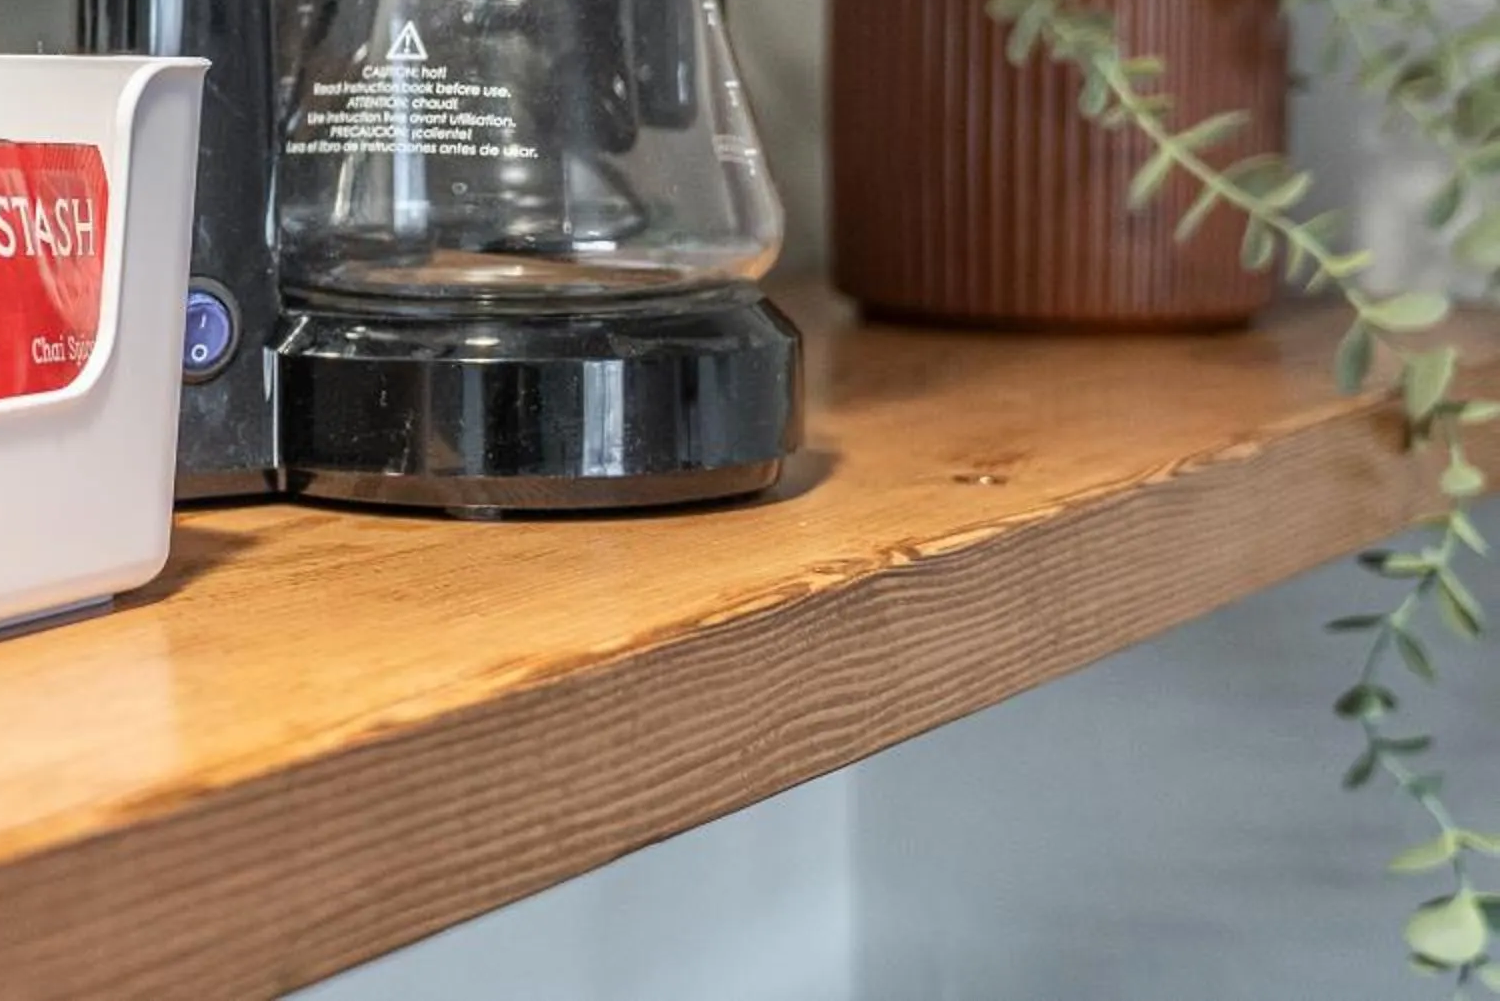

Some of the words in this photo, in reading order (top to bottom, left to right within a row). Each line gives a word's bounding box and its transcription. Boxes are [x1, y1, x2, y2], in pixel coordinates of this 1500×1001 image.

[421, 66, 447, 80] hot!
[402, 82, 434, 95] book
[435, 82, 481, 96] before
[483, 85, 512, 98] use.
[411, 97, 459, 110] chaud!
[409, 112, 447, 124] avant
[449, 113, 517, 128] utilisation.
[438, 143, 477, 156] antes
[479, 144, 500, 157] de
[502, 146, 539, 159] usar.
[31, 334, 66, 365] Chai
